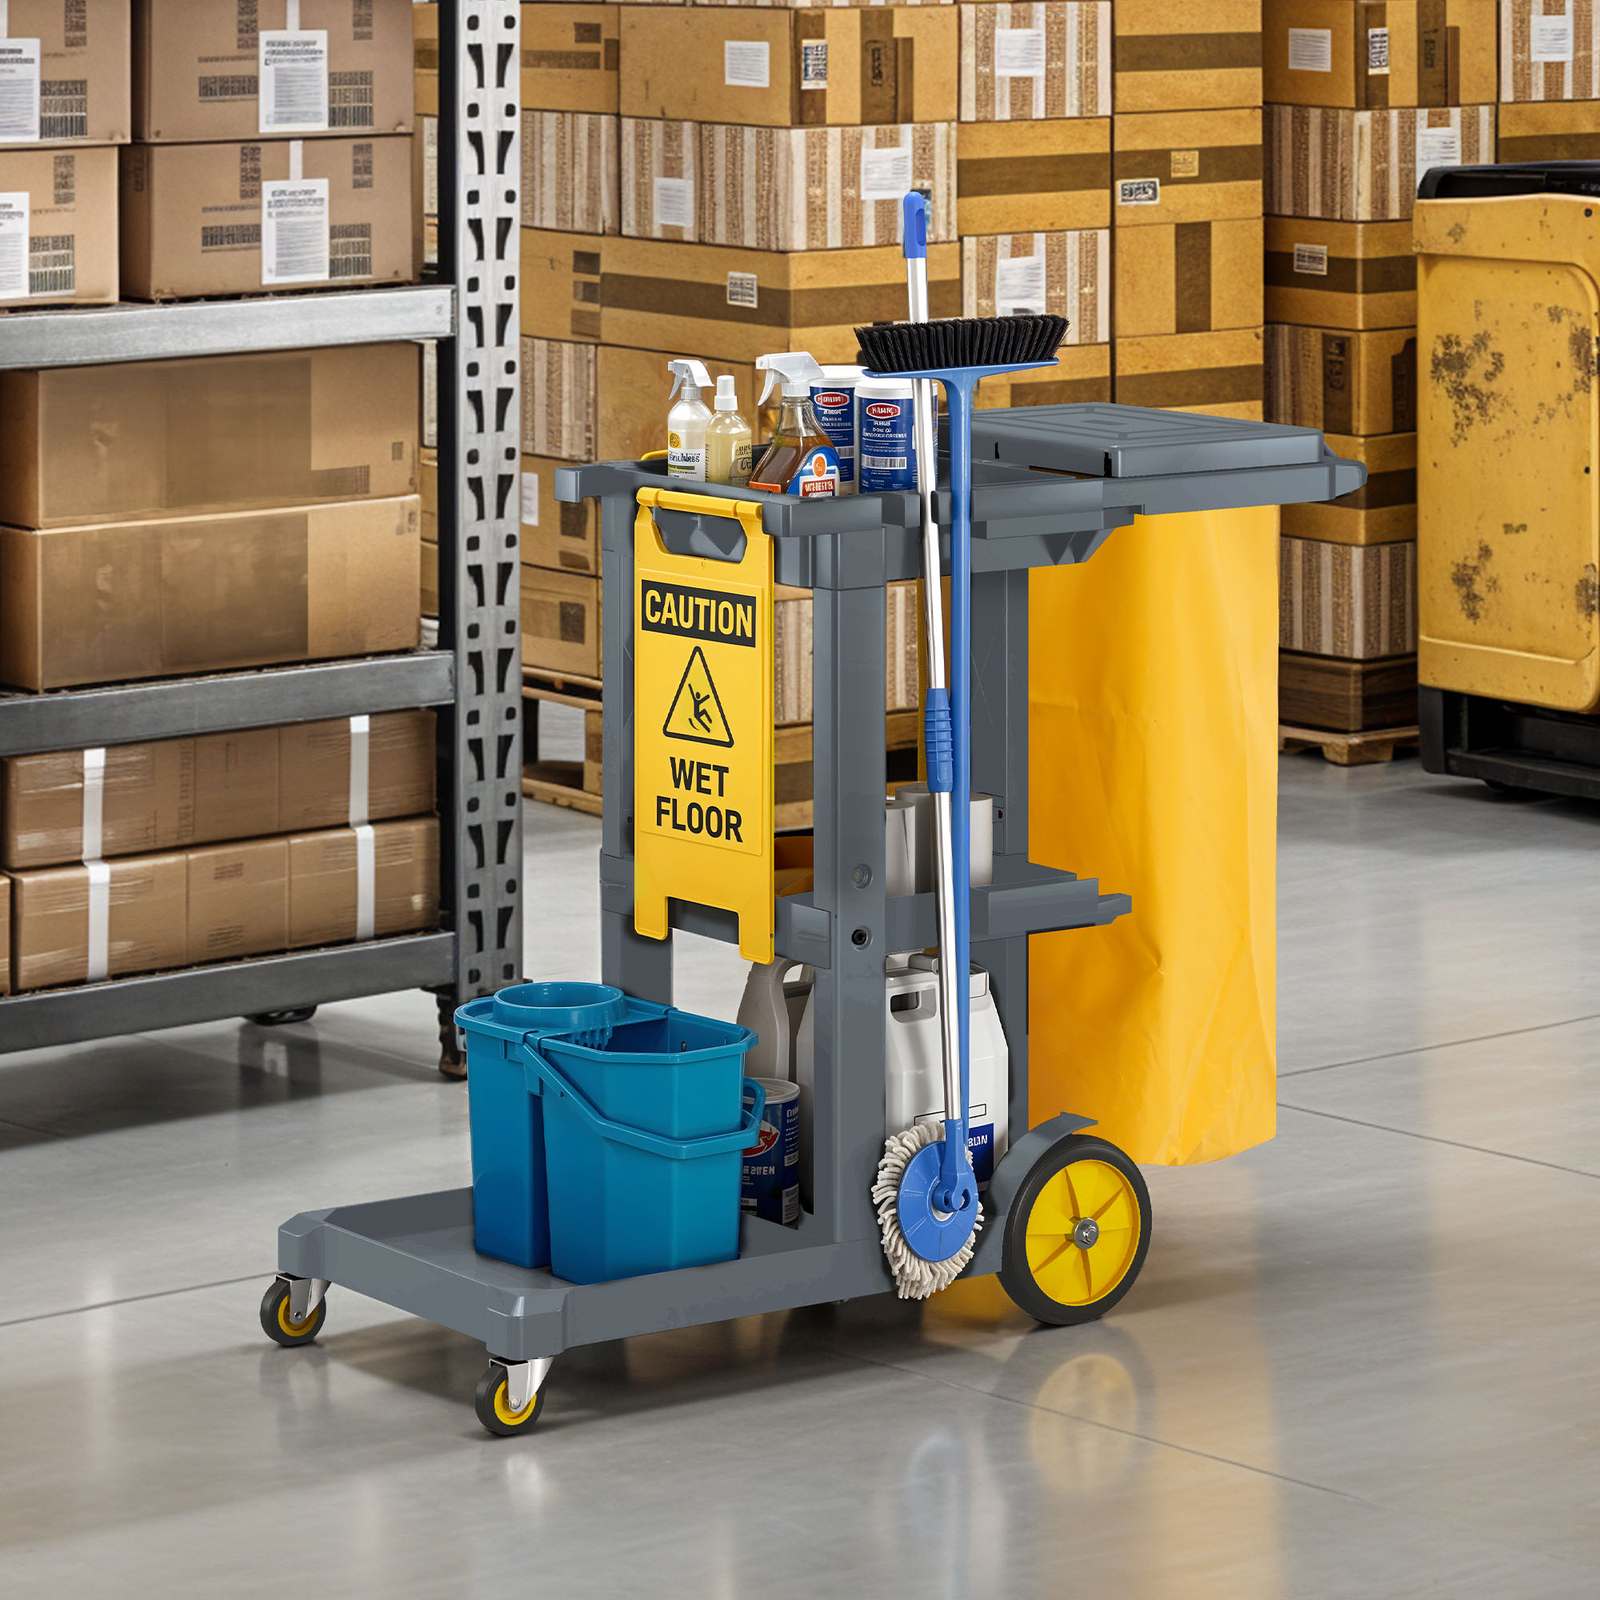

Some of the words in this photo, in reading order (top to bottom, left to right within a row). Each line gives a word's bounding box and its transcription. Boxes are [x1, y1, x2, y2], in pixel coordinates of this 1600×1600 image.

[645, 589, 753, 638] CAUTION
[669, 756, 730, 797] WET
[656, 795, 743, 843] FLOOR
